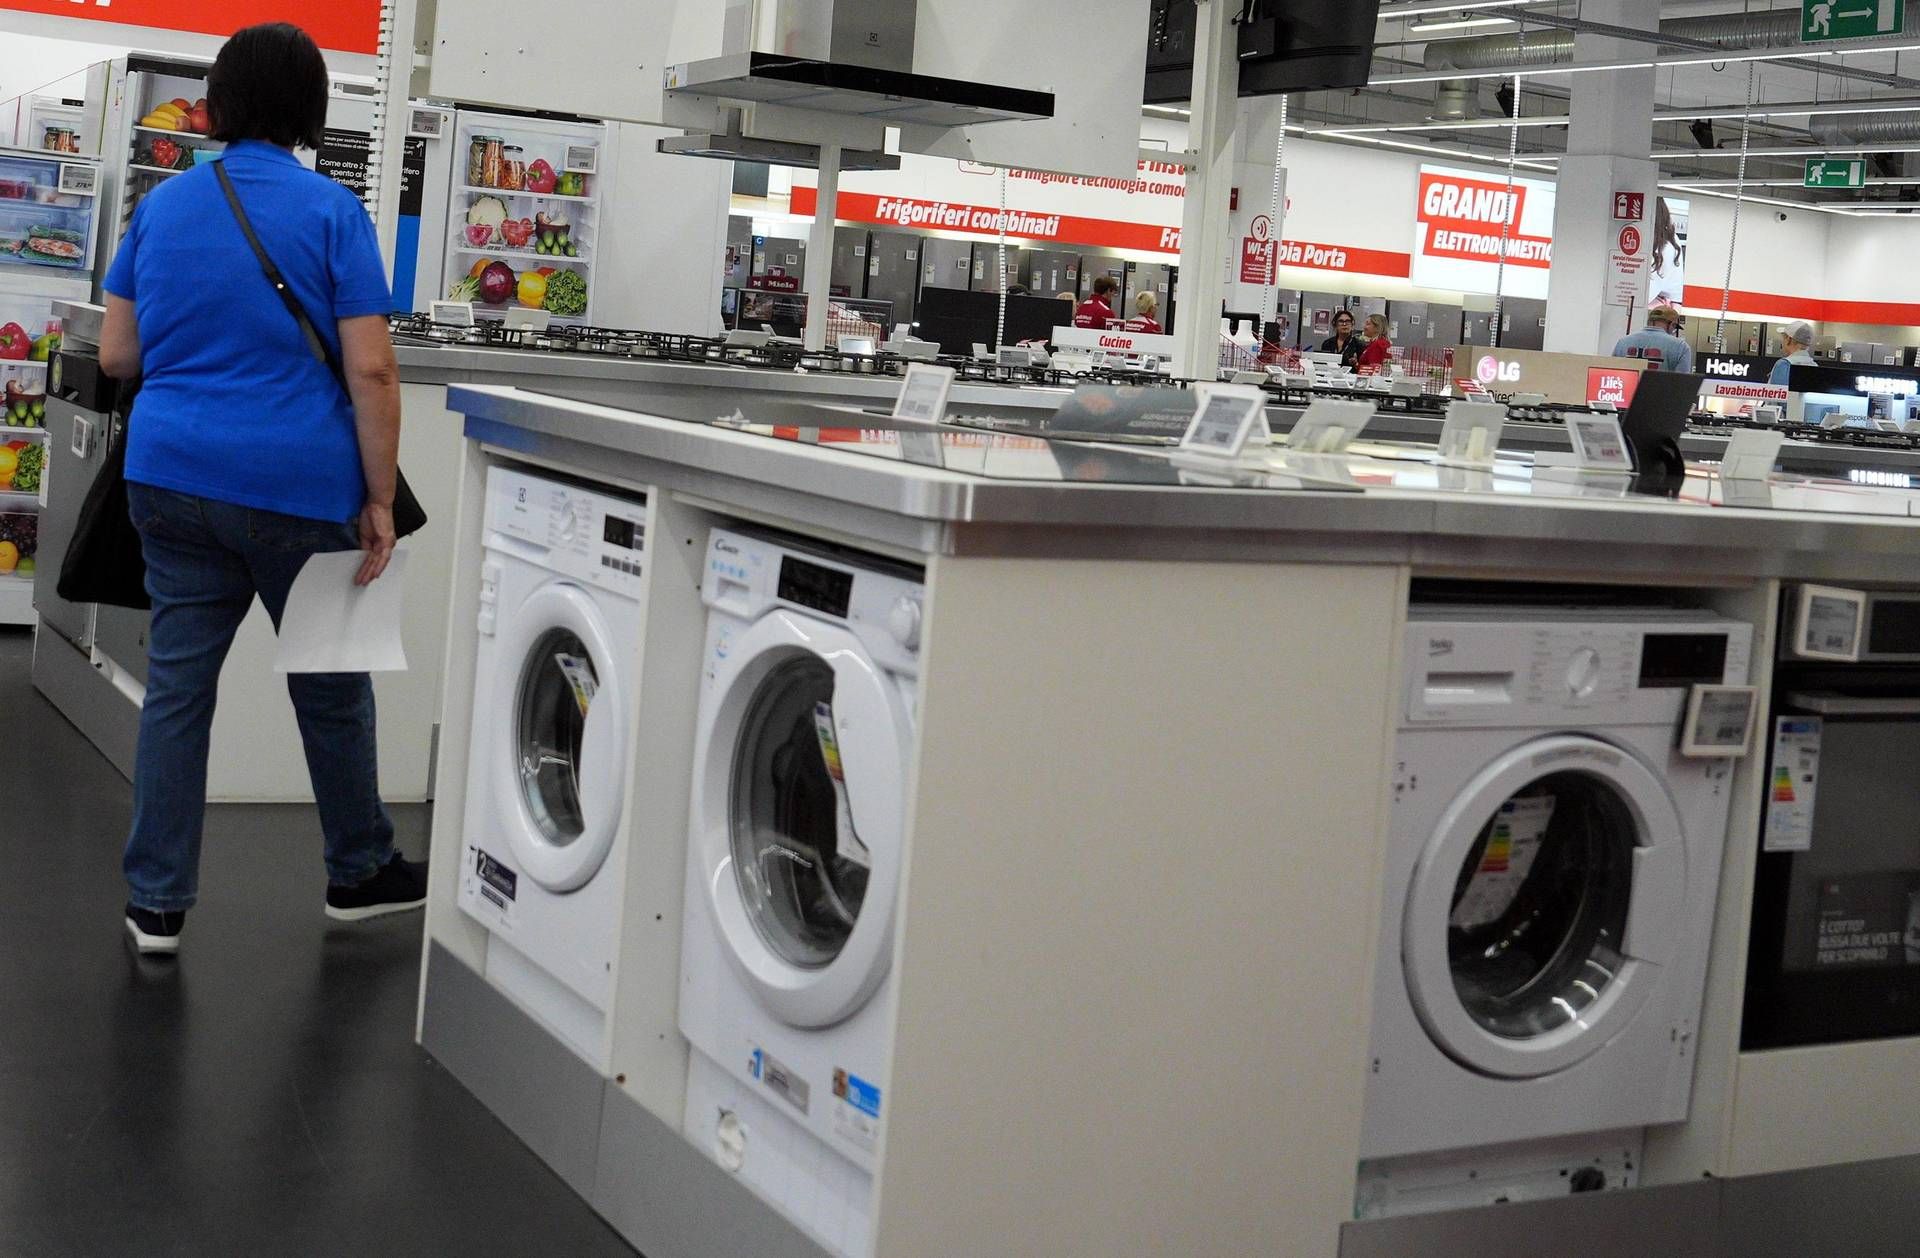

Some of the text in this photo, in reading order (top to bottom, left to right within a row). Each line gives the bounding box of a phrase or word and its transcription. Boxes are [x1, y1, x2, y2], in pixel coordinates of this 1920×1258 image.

[320, 158, 341, 168] Come
[342, 161, 358, 169] oltre
[330, 169, 354, 178] spento
[1081, 176, 1147, 195] tecnologia
[1424, 182, 1518, 226] GRANDI
[875, 196, 1060, 237] Frigoriferi combinati
[1302, 242, 1347, 268] Porta
[767, 280, 795, 289] Miele
[1098, 335, 1132, 349] Cucine
[1498, 361, 1521, 382] LG
[1706, 358, 1750, 377] Haier
[1600, 375, 1624, 390] Life's
[1597, 388, 1625, 403] Good.
[1715, 383, 1788, 400] Lavabiancheria
